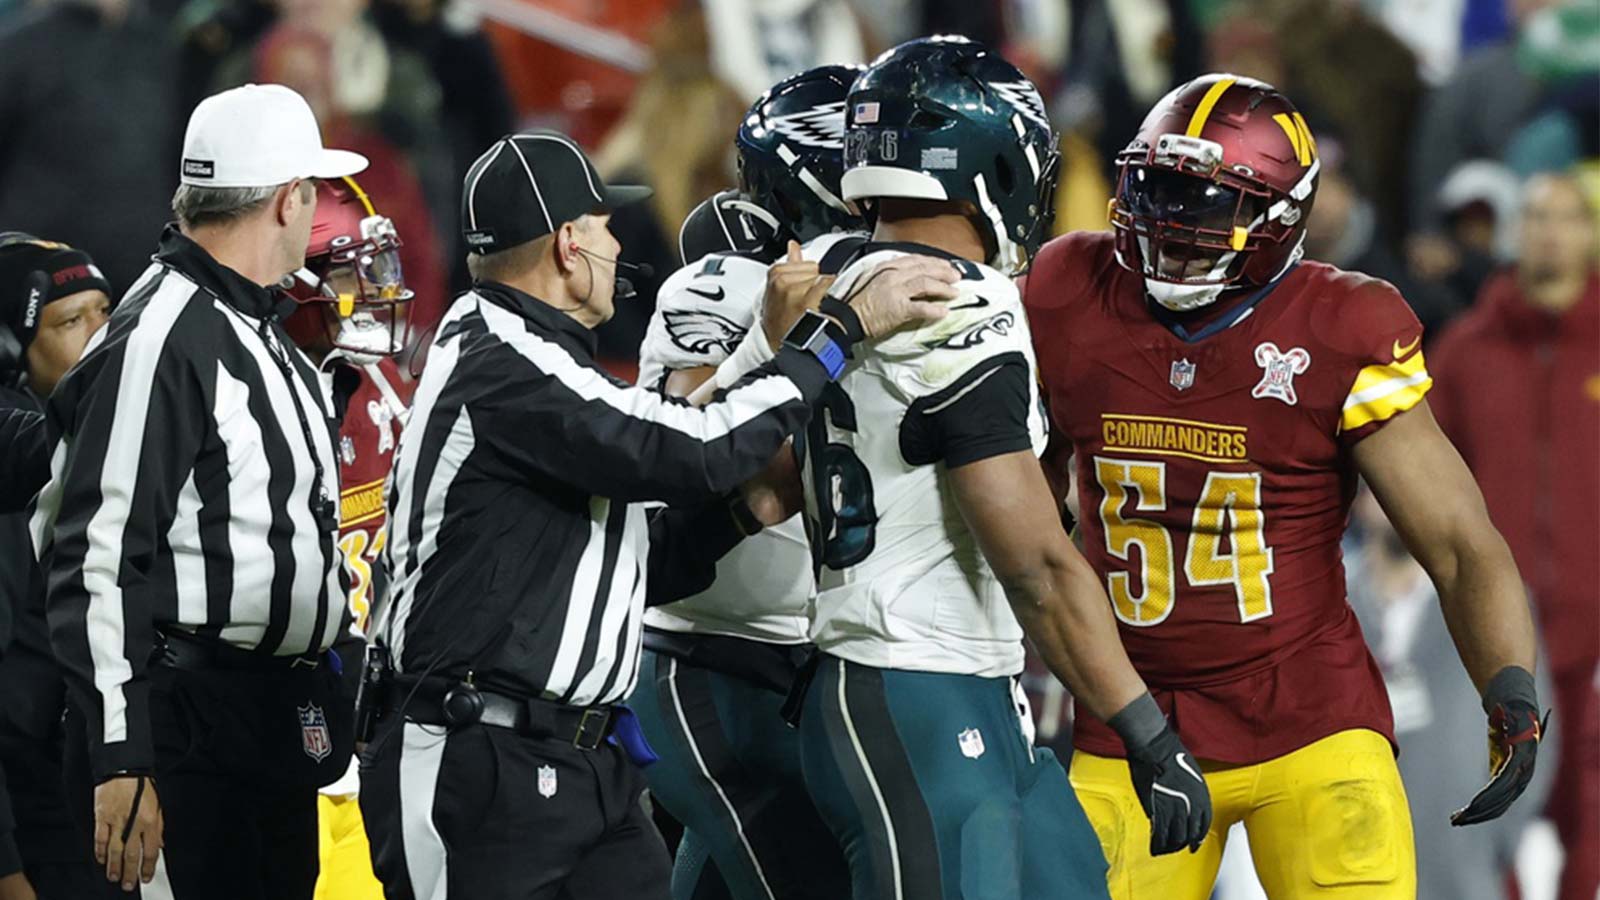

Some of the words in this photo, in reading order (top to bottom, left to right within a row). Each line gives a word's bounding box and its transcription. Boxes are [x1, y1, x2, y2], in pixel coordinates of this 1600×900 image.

[24, 288, 40, 328] SONY
[795, 380, 878, 580] 6
[1102, 420, 1247, 458] COMMANDERS
[1092, 455, 1275, 627] 54
